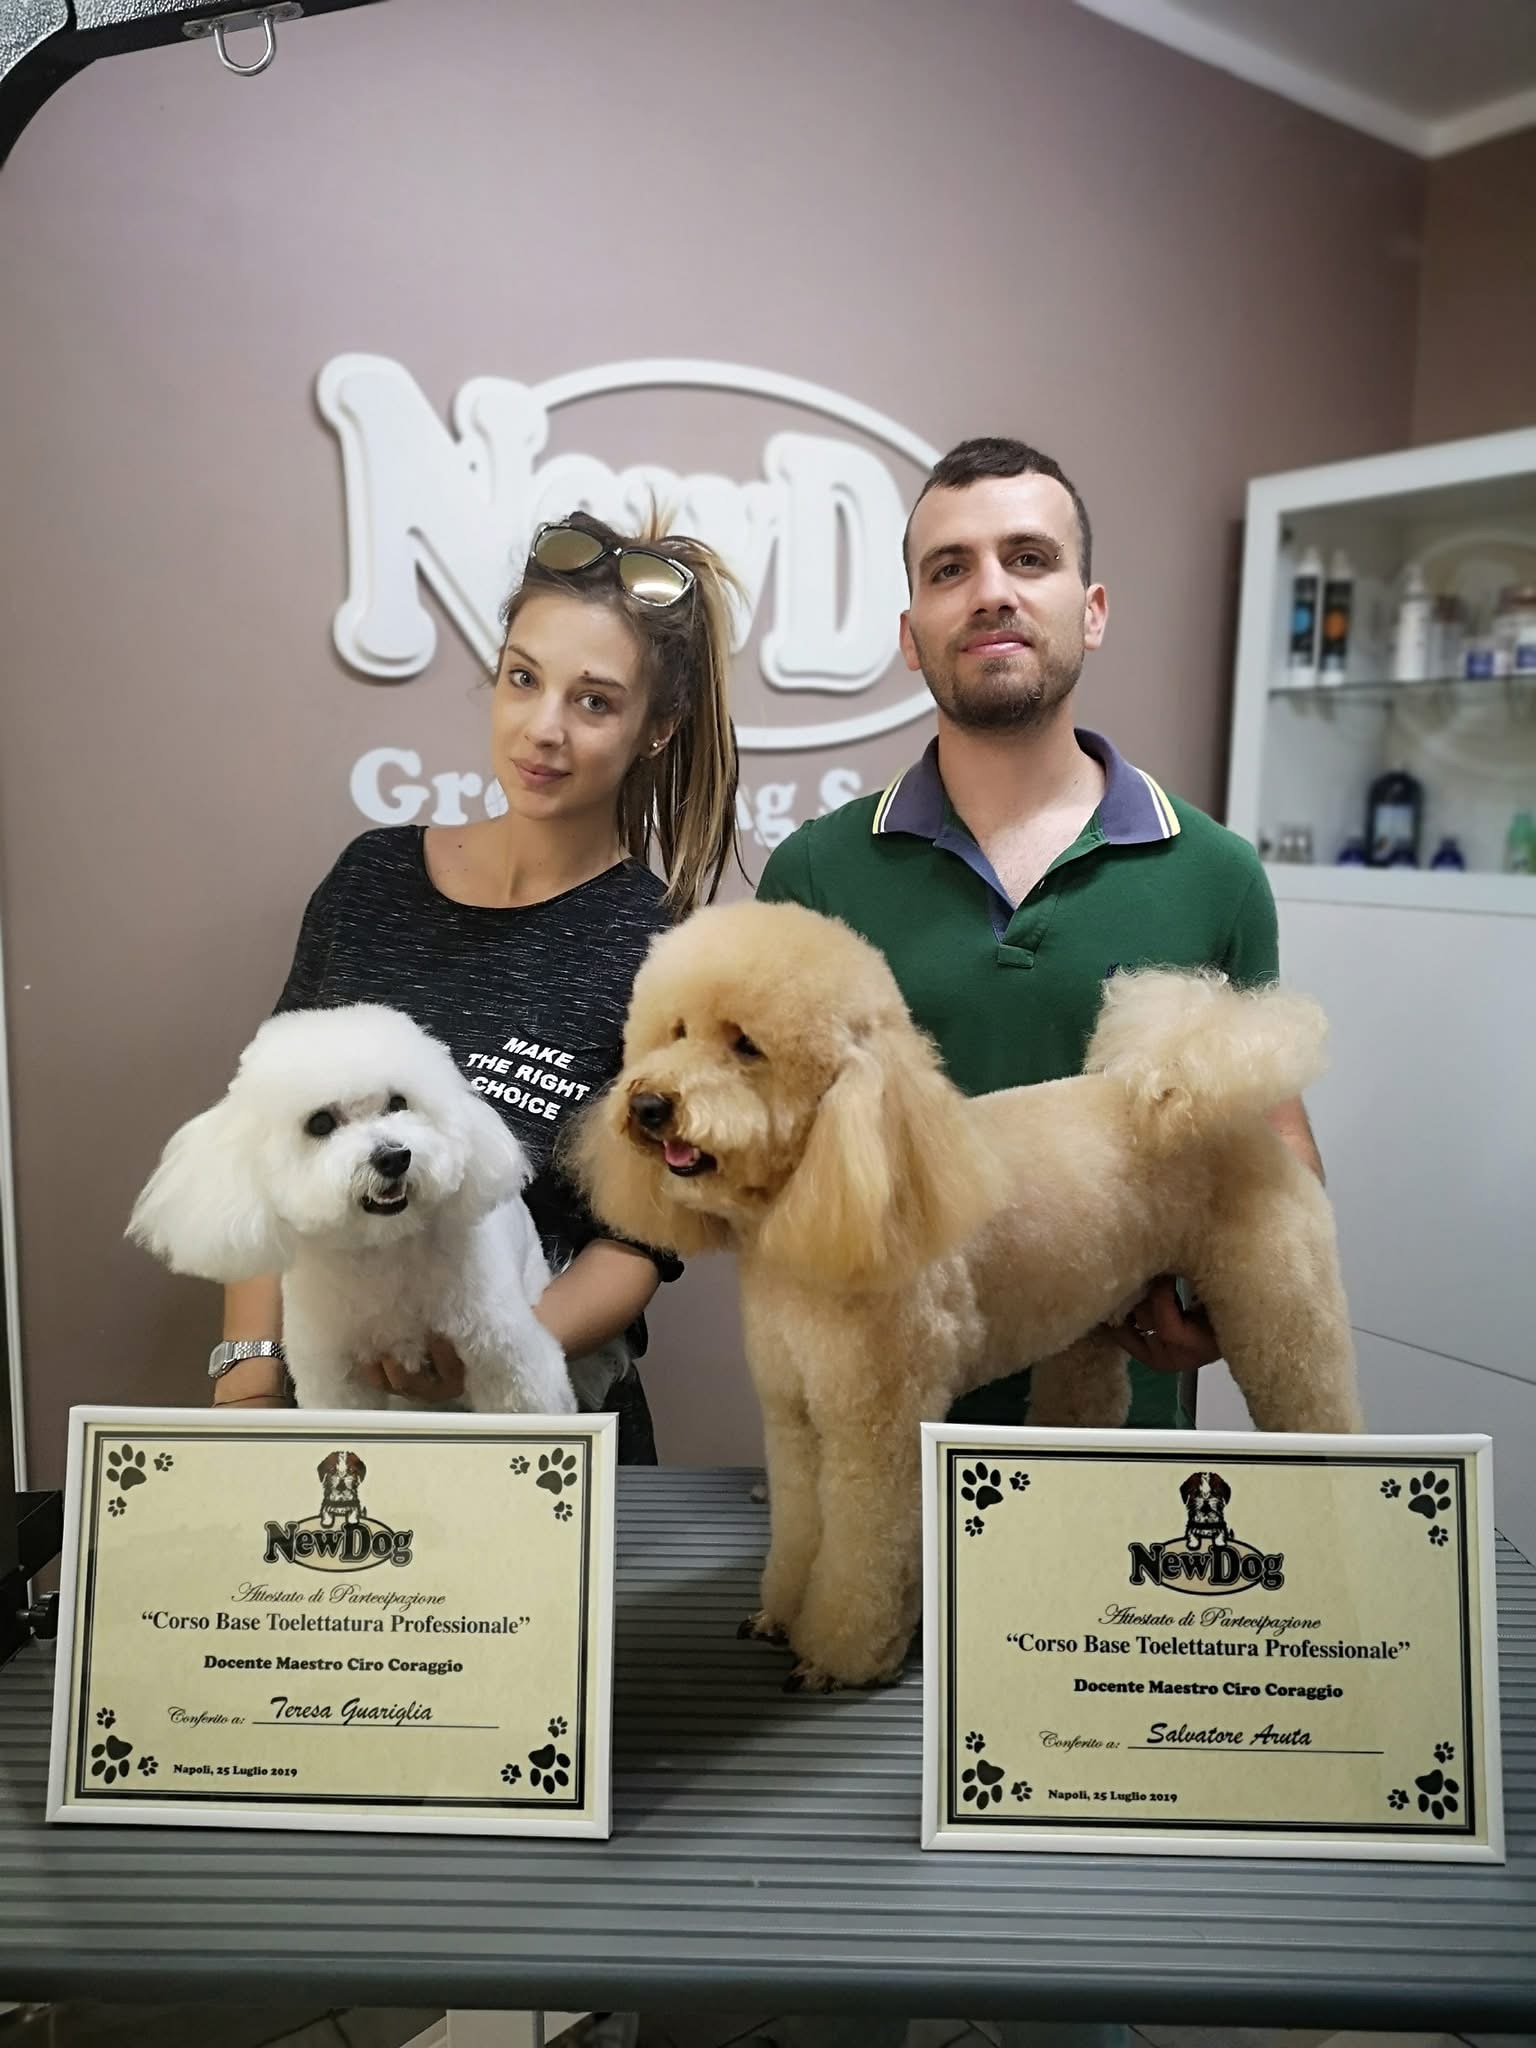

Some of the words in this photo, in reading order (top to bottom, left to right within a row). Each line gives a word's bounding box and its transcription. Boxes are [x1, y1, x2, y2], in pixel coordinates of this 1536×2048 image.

[502, 1037, 575, 1070] MAKE
[467, 1053, 513, 1074] THE
[514, 1064, 591, 1101] RIGHT
[471, 1076, 561, 1121] CHOICE
[264, 1521, 413, 1568] NewDog
[1130, 1542, 1284, 1592] NewDog
[230, 1581, 306, 1604] Attestato
[307, 1587, 325, 1604] di
[328, 1583, 447, 1613] Partecipazione
[215, 1611, 261, 1632] Base
[265, 1612, 385, 1633] Toelettatura
[1097, 1603, 1176, 1627] Attestato
[1177, 1610, 1196, 1627] di
[1199, 1606, 1322, 1637] Partecipazione
[1082, 1634, 1131, 1655] Base
[1135, 1635, 1260, 1657] Toelettatura
[203, 1654, 273, 1670] Docente
[275, 1656, 344, 1671] Maestro
[346, 1657, 385, 1672] Ciro
[387, 1657, 464, 1676] Coraggio
[1072, 1678, 1146, 1694] Docente
[1147, 1679, 1220, 1696] Maestro
[1221, 1681, 1262, 1697] Ciro
[1264, 1682, 1344, 1702] Coraggio
[167, 1705, 230, 1729] Conferito
[230, 1716, 246, 1725] a:
[269, 1695, 334, 1720] Teresa
[337, 1696, 436, 1728] Guariglia
[1038, 1730, 1104, 1753] Conferito
[1105, 1741, 1121, 1750] a:
[1145, 1721, 1244, 1745] Salvatore
[1248, 1722, 1313, 1747] Aruta
[172, 1763, 215, 1777] Napoli,
[215, 1766, 231, 1777] 25
[231, 1764, 269, 1778] Luglio
[270, 1767, 298, 1778] 2019
[1047, 1788, 1091, 1802] Napoli,
[1092, 1791, 1108, 1802] 25
[1109, 1790, 1148, 1804] Luglio
[1148, 1792, 1178, 1804] 2019
